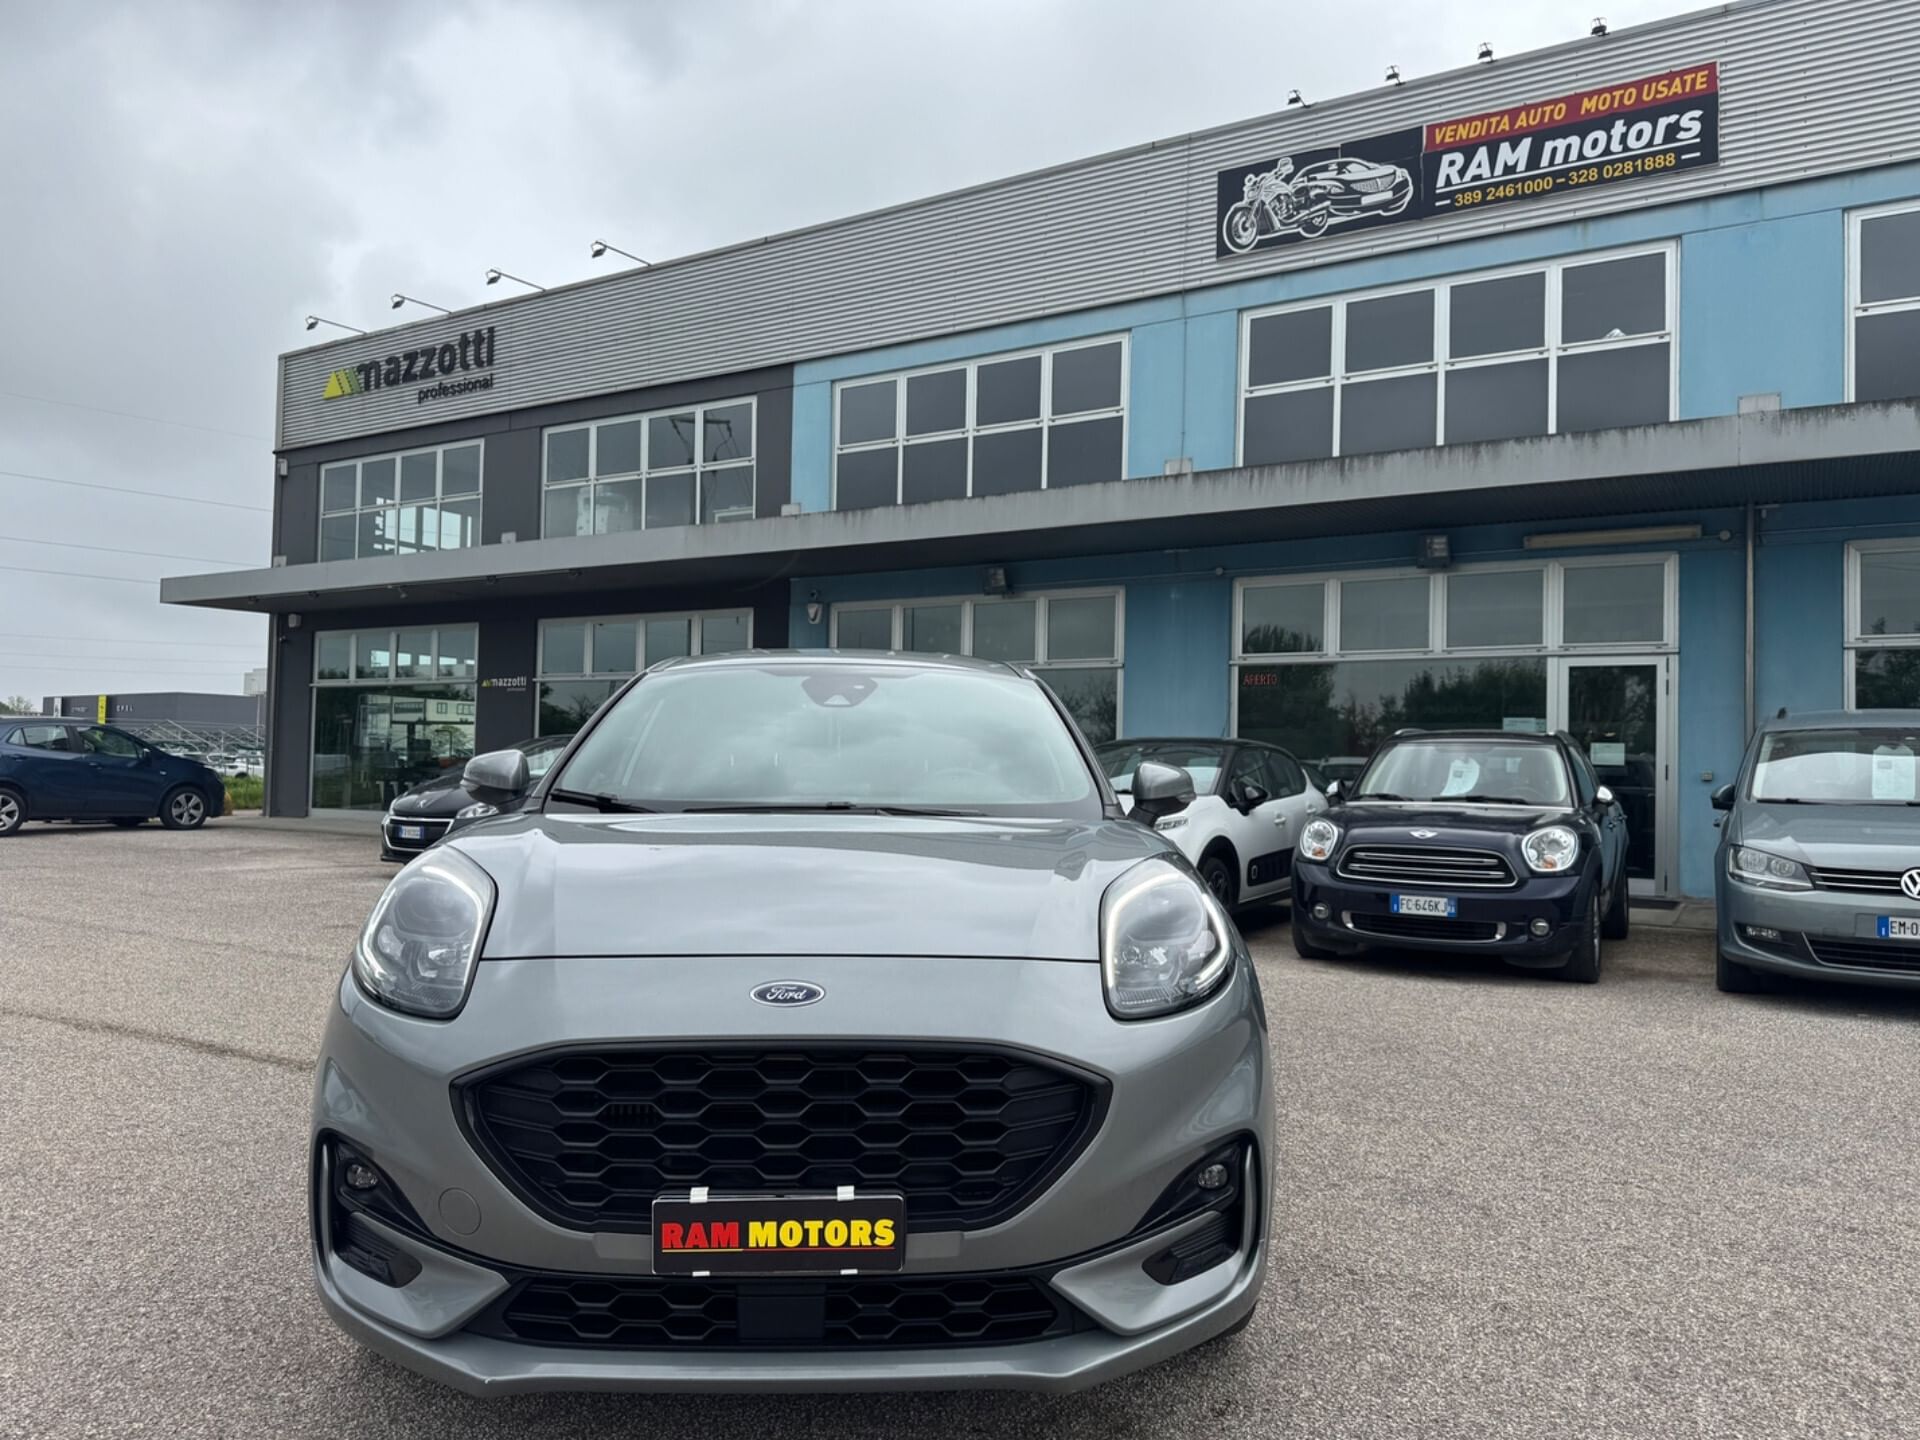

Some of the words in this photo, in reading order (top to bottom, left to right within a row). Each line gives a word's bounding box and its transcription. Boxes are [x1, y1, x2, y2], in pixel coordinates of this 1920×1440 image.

[1435, 114, 1510, 144] VENDITA
[1514, 102, 1567, 130] AUTO
[1580, 87, 1637, 115] MOTO
[1642, 70, 1709, 102] USATE
[1436, 136, 1533, 189] RAM
[1540, 109, 1704, 168] motors
[1454, 190, 1483, 207] 389
[1486, 176, 1553, 201] 2461000
[1568, 167, 1599, 185] 328
[1602, 152, 1676, 179] 0281888
[418, 373, 494, 404] professional
[766, 986, 807, 1000] Ford
[662, 1222, 740, 1249] RAM
[748, 1219, 896, 1248] MOTORS
